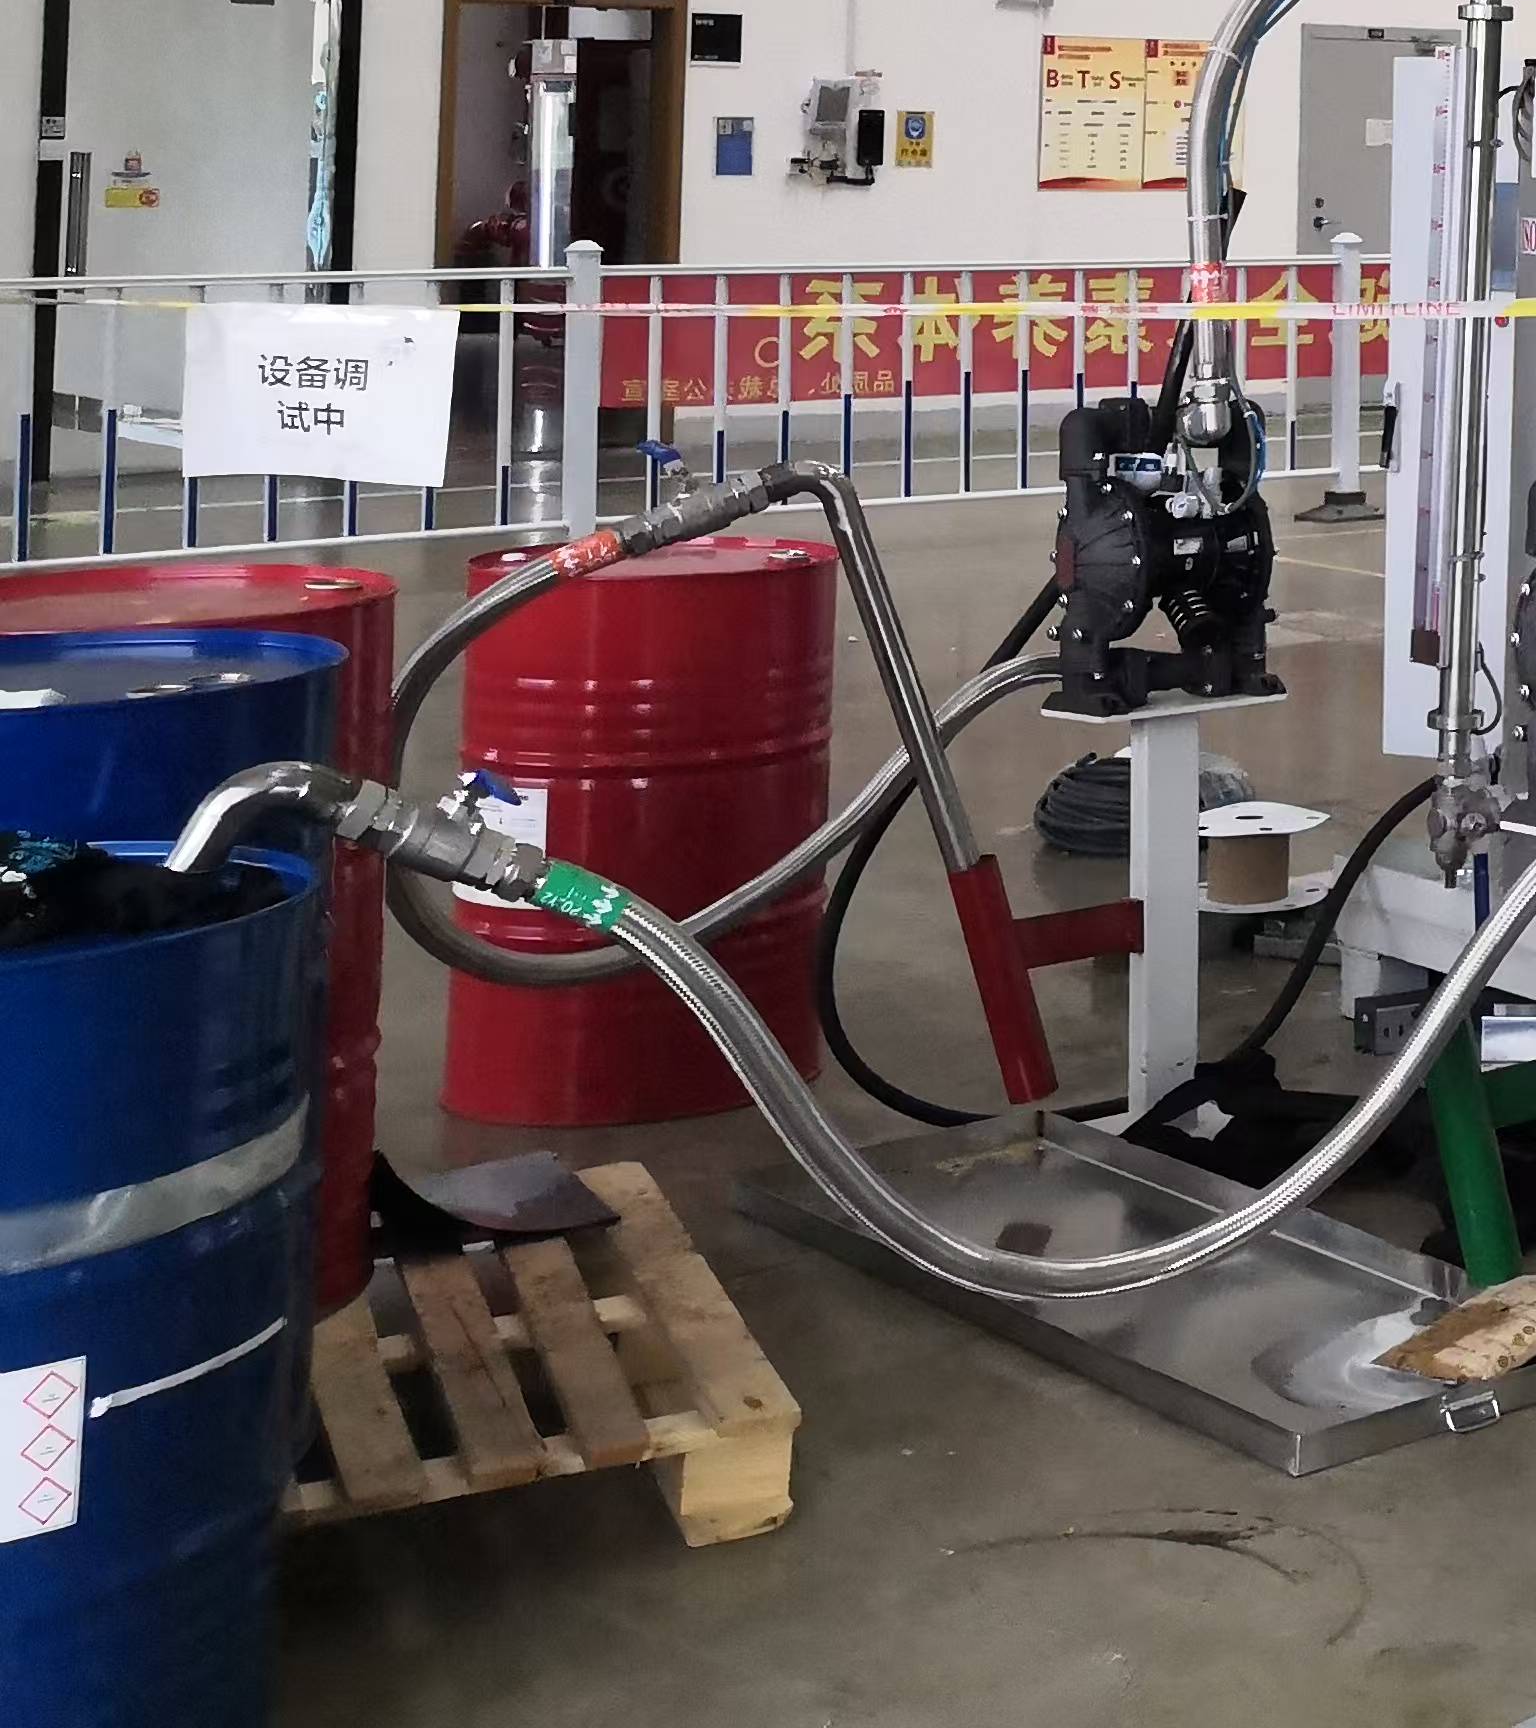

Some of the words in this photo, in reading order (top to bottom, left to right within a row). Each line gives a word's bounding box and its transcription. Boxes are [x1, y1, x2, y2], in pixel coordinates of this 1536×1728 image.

[1046, 69, 1059, 88] B
[1077, 70, 1091, 89] T
[1109, 70, 1121, 90] S
[258, 354, 369, 391] 设备调
[277, 400, 345, 435] 试中
